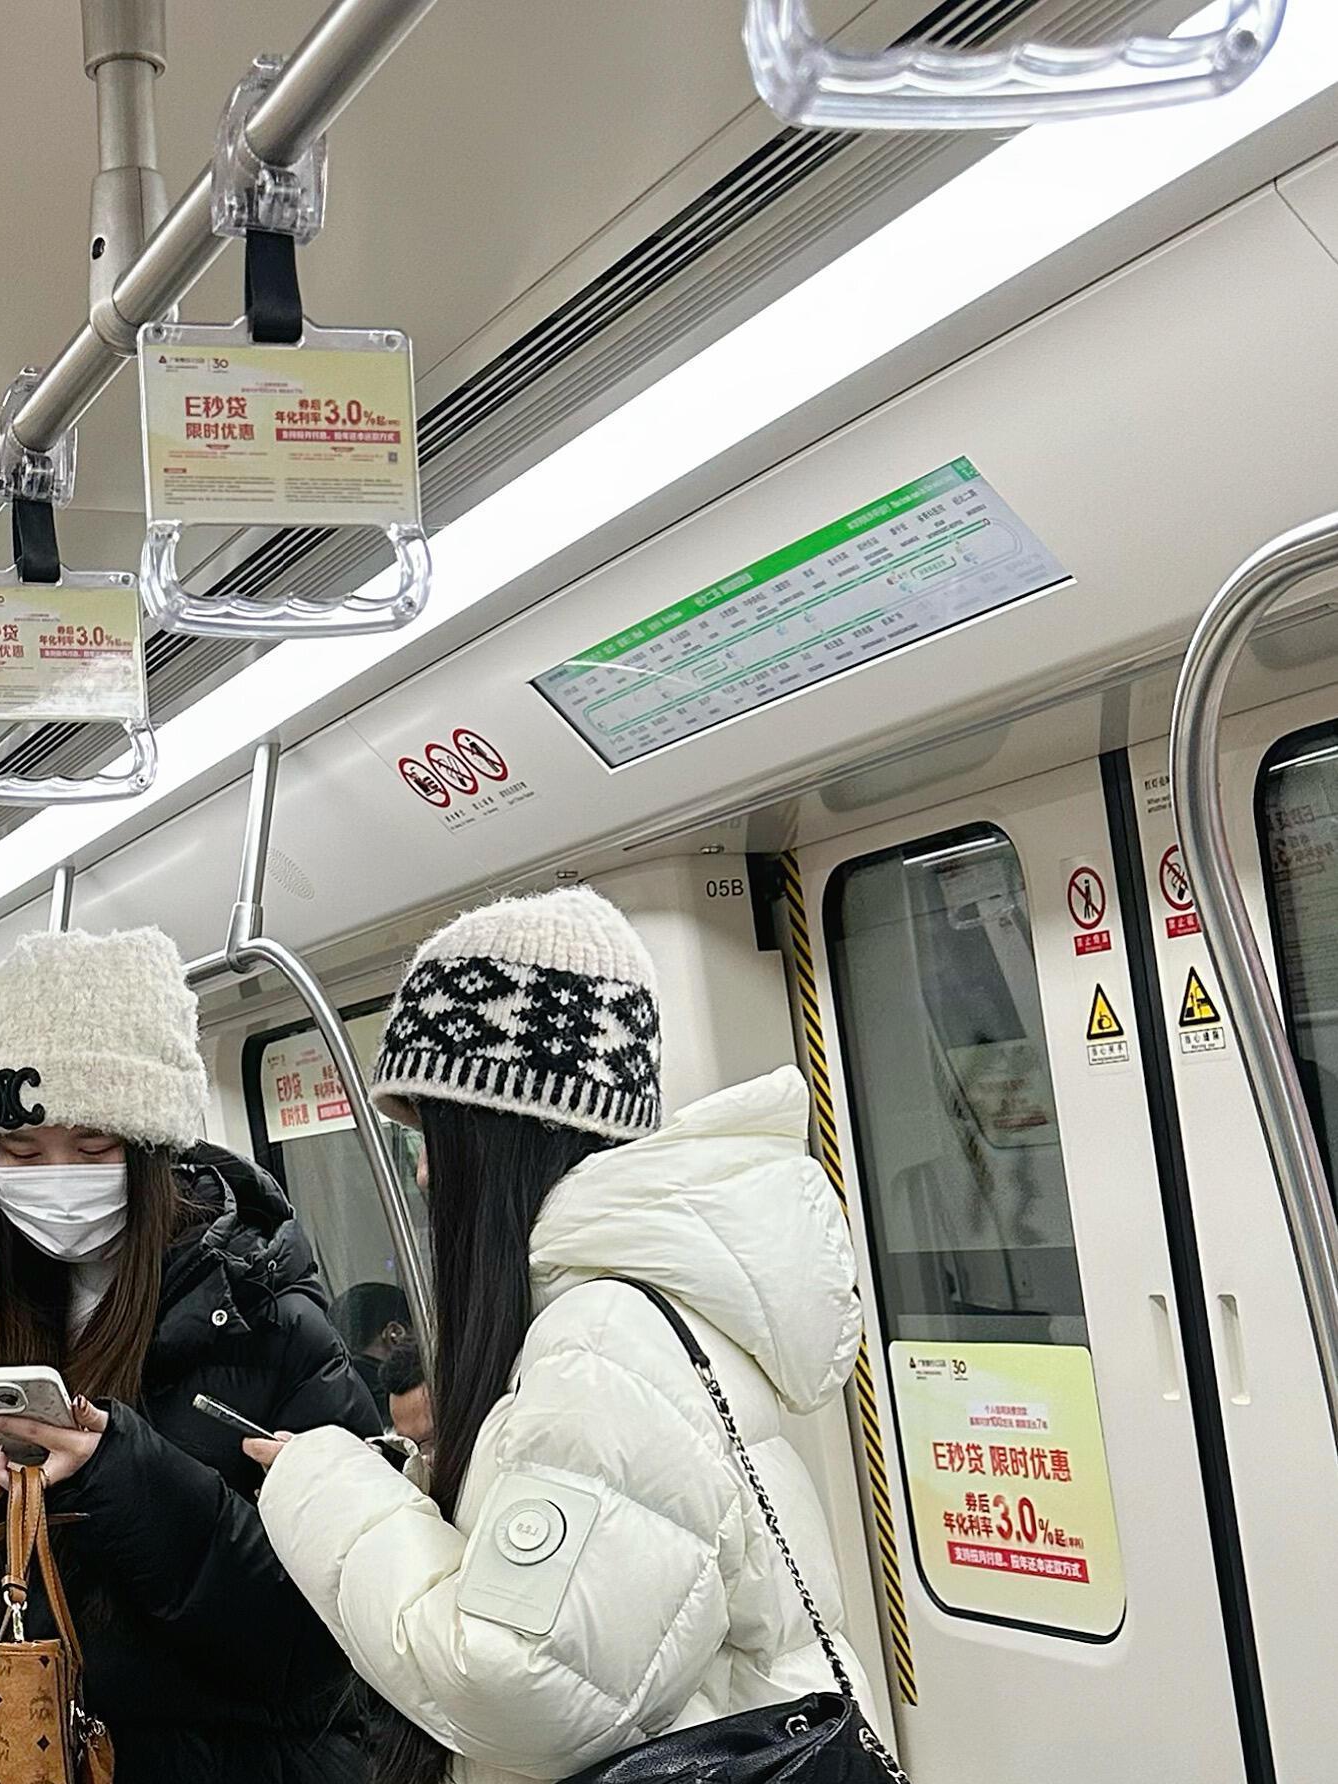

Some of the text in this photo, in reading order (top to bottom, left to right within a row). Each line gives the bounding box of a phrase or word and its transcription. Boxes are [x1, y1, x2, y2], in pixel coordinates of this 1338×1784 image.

[185, 395, 247, 419] E秒贷
[186, 422, 255, 441] 限时优惠
[706, 879, 744, 898] 05B
[932, 1442, 1072, 1482] E秒贷 限时优惠
[965, 1491, 991, 1513] 券后
[943, 1511, 994, 1538] 年化利率
